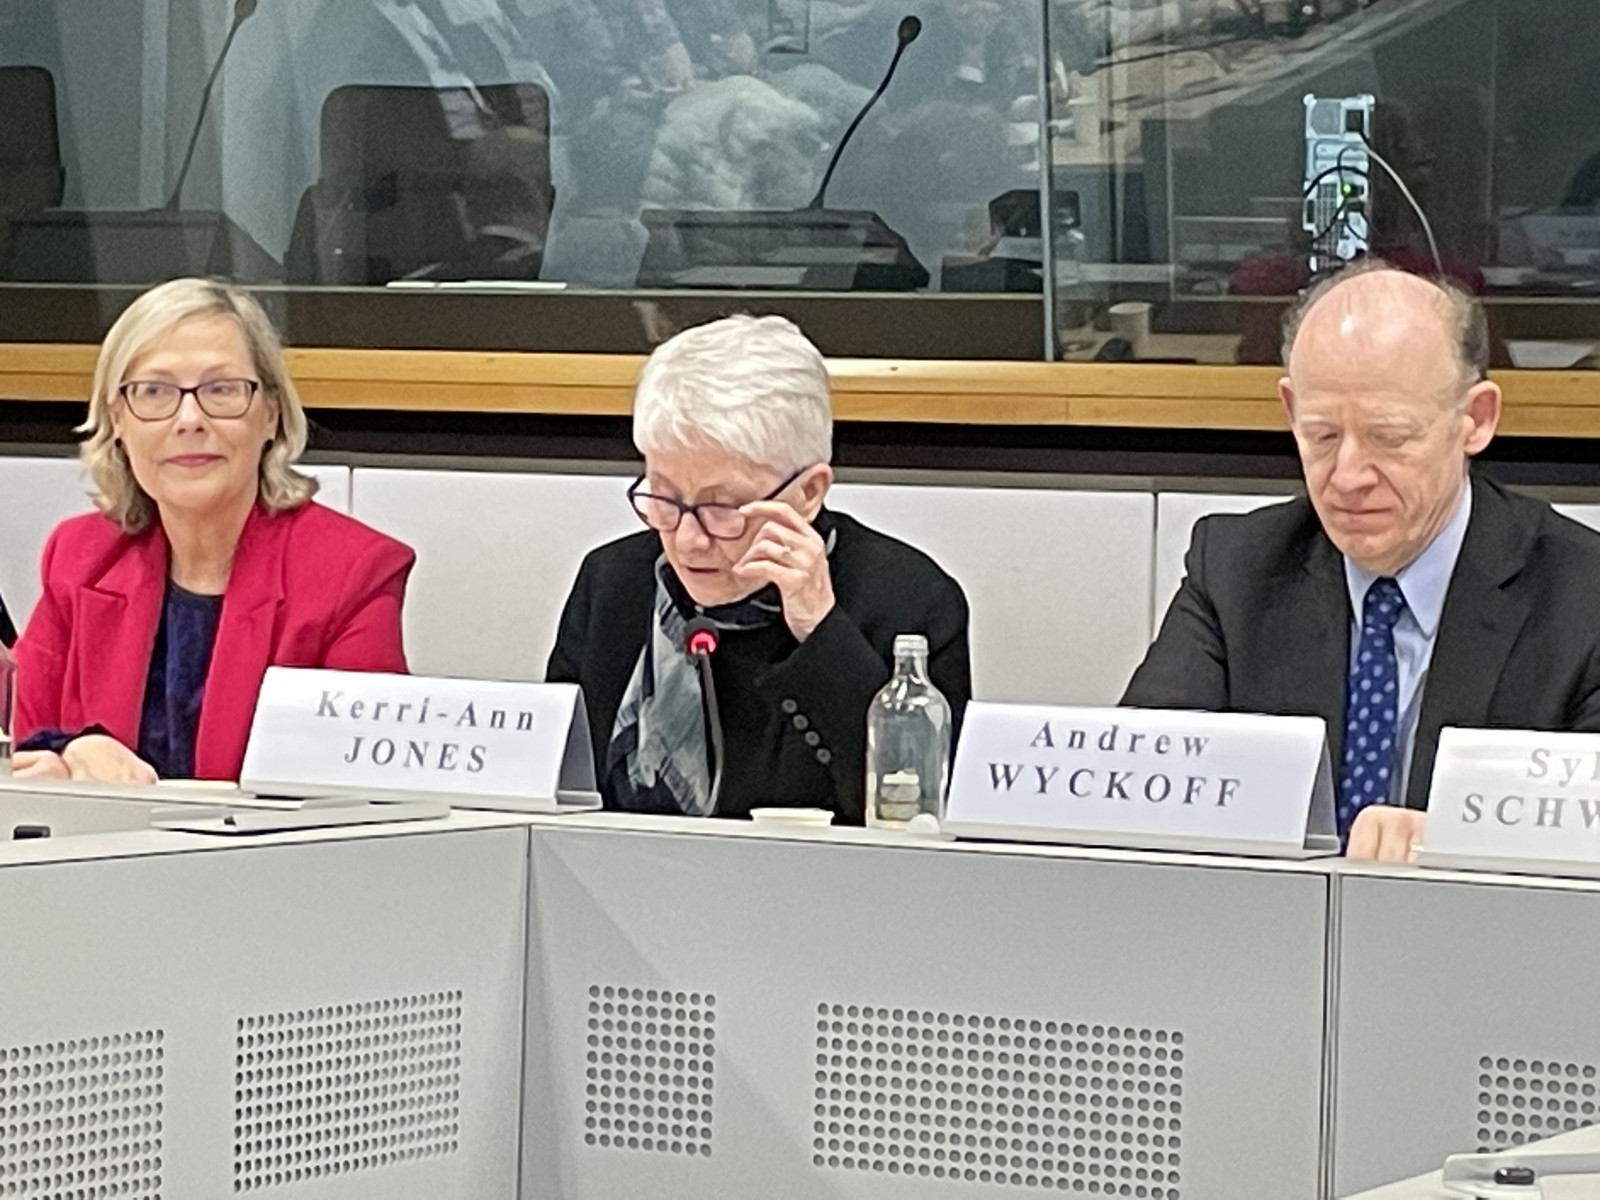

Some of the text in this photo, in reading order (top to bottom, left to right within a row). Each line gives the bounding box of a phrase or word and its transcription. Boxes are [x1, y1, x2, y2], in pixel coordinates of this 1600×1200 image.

[315, 690, 535, 731] Kerri-Ann
[344, 736, 488, 773] JONES
[1029, 720, 1210, 758] Andrew
[988, 762, 1241, 808] WYCKOFF
